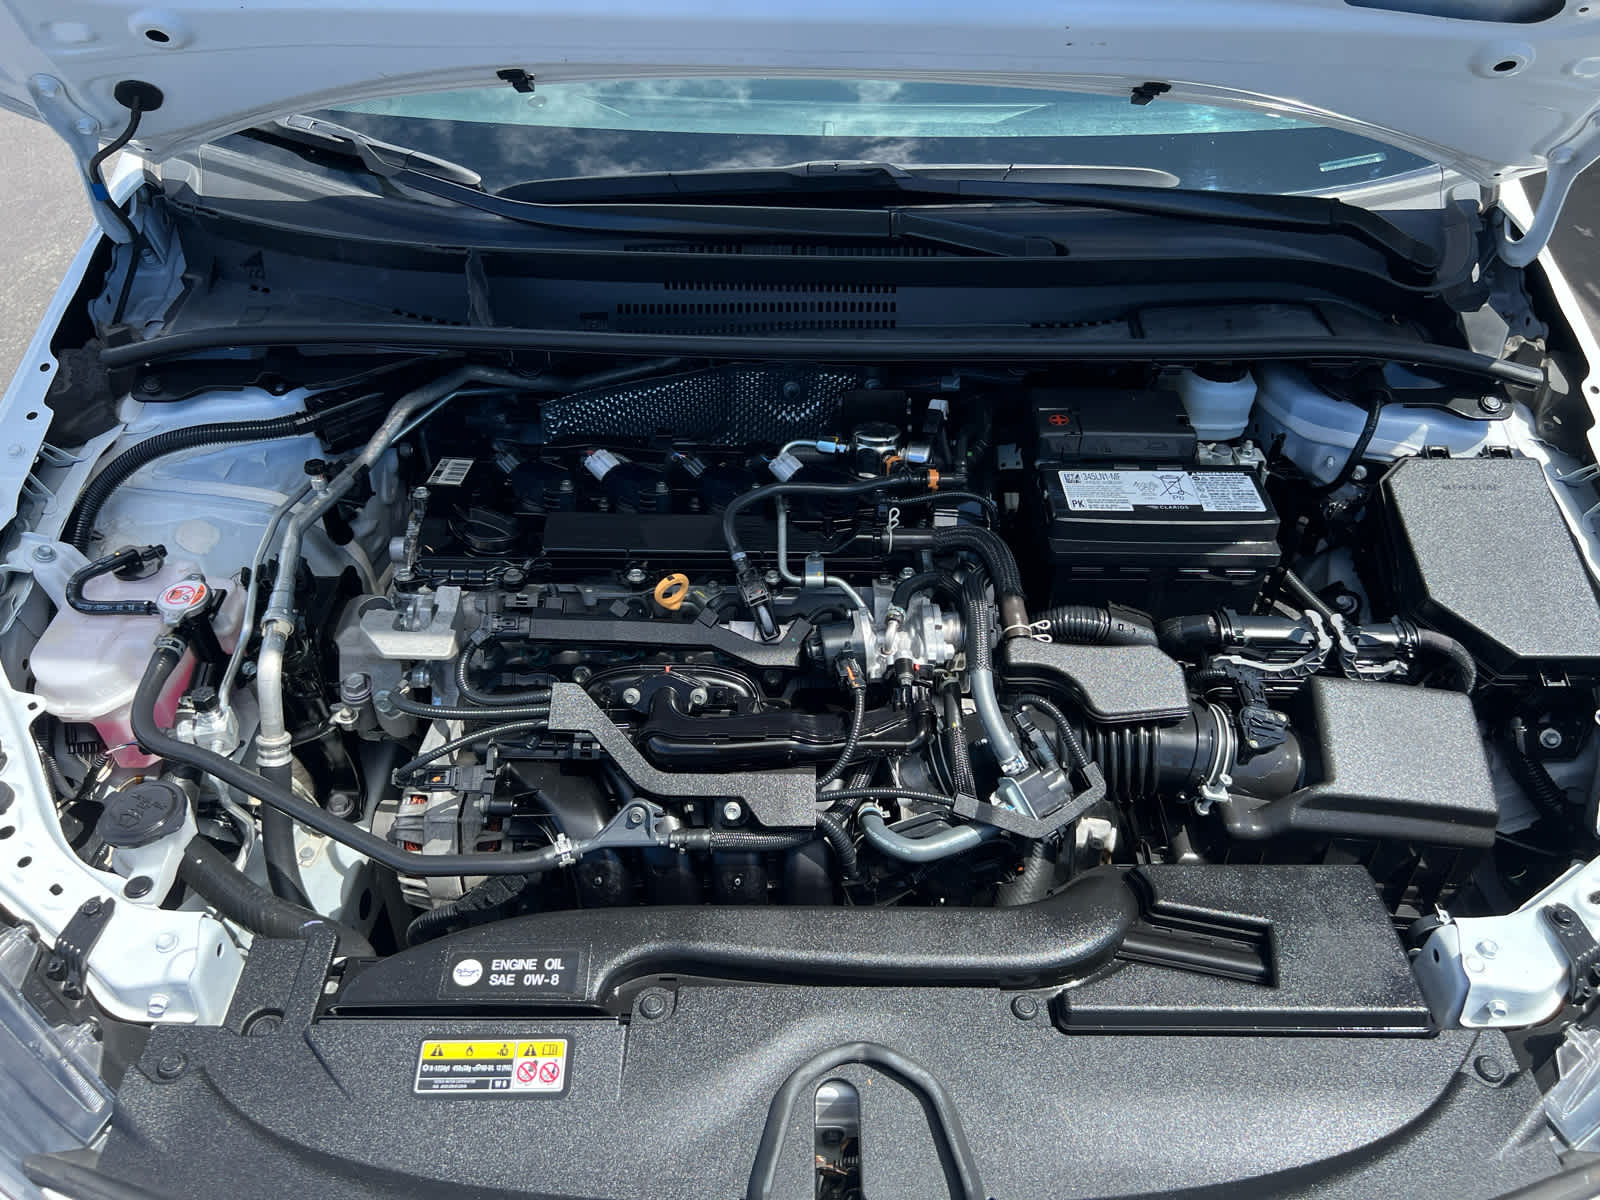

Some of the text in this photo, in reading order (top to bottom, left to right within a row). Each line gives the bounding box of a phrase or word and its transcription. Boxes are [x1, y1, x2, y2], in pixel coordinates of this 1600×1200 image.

[1072, 499, 1085, 508] PK
[491, 957, 565, 971] ENGINE OIL
[488, 973, 560, 986] SAE 0W-8
